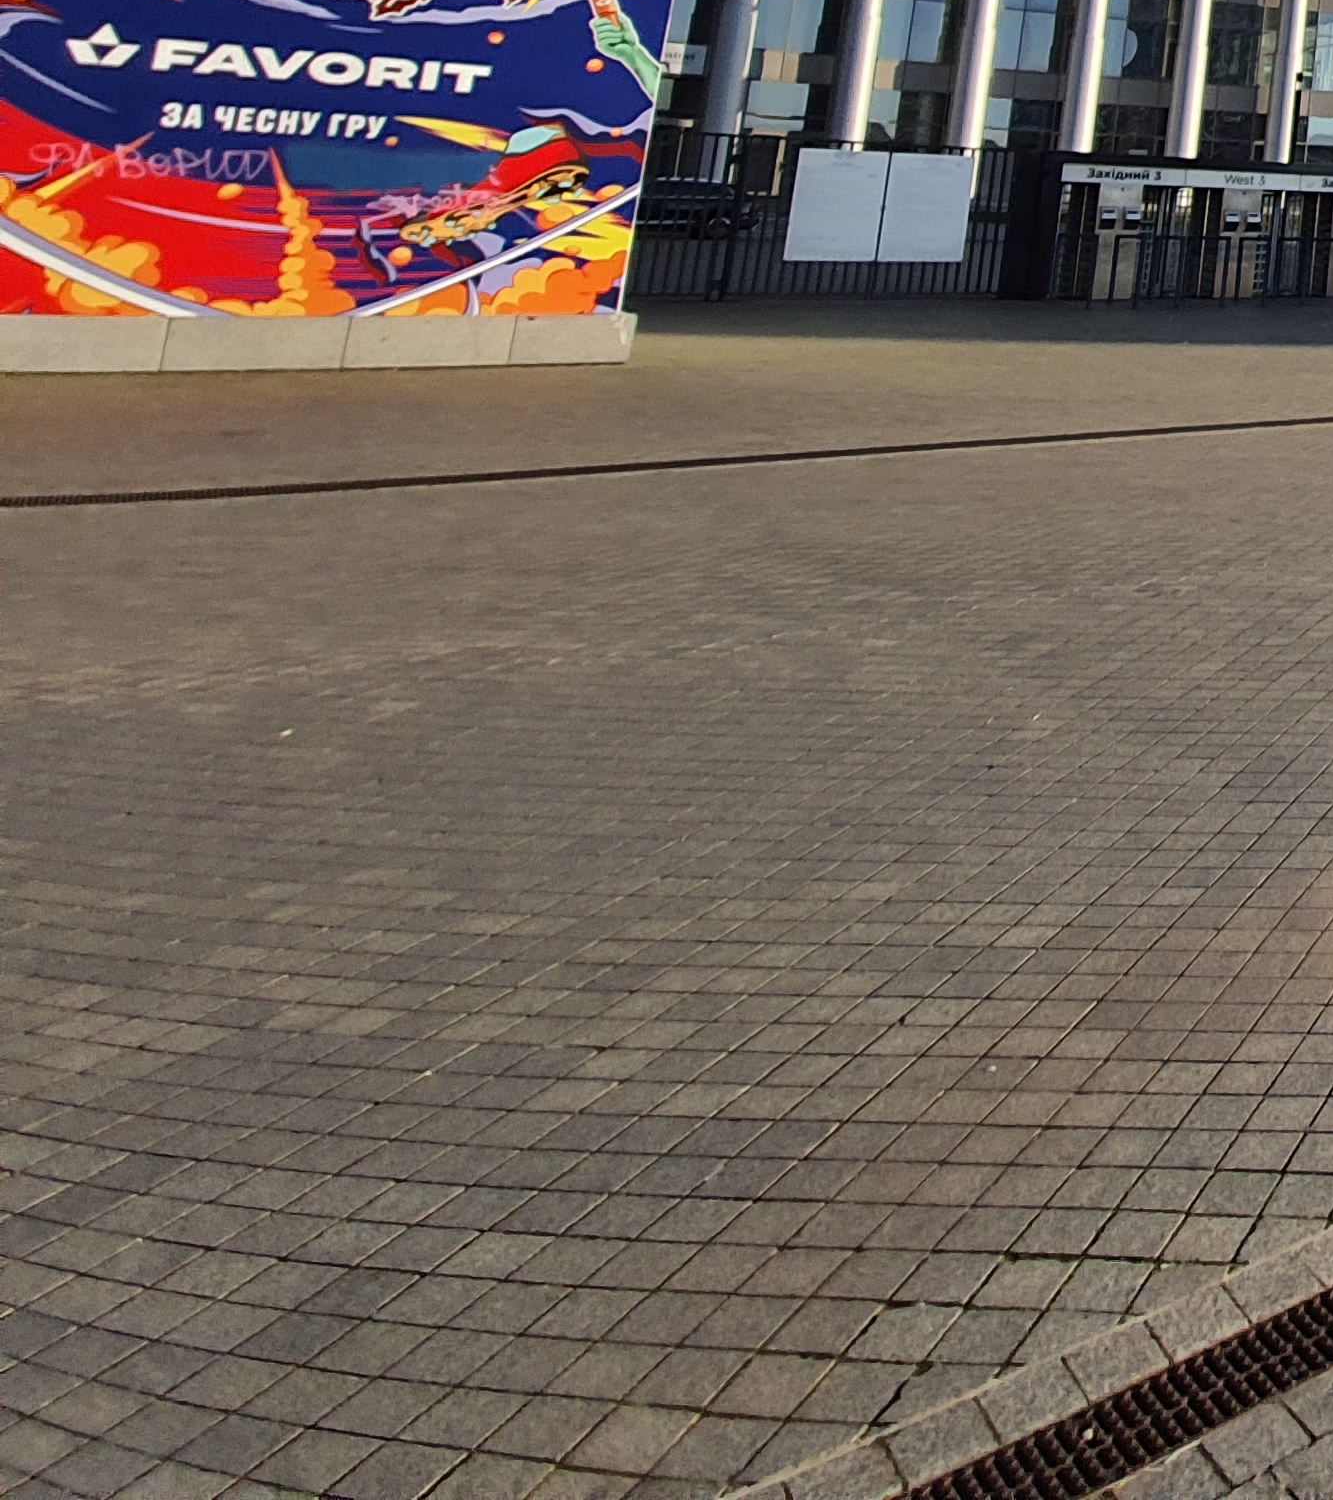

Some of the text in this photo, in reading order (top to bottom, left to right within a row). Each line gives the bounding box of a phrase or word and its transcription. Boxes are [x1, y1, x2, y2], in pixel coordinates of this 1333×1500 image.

[151, 38, 493, 94] FAVORIT
[159, 102, 389, 140] ЗА ЧЕСНУ ГРУ
[1086, 167, 1162, 182] Західний 3
[1223, 174, 1266, 187] West 3
